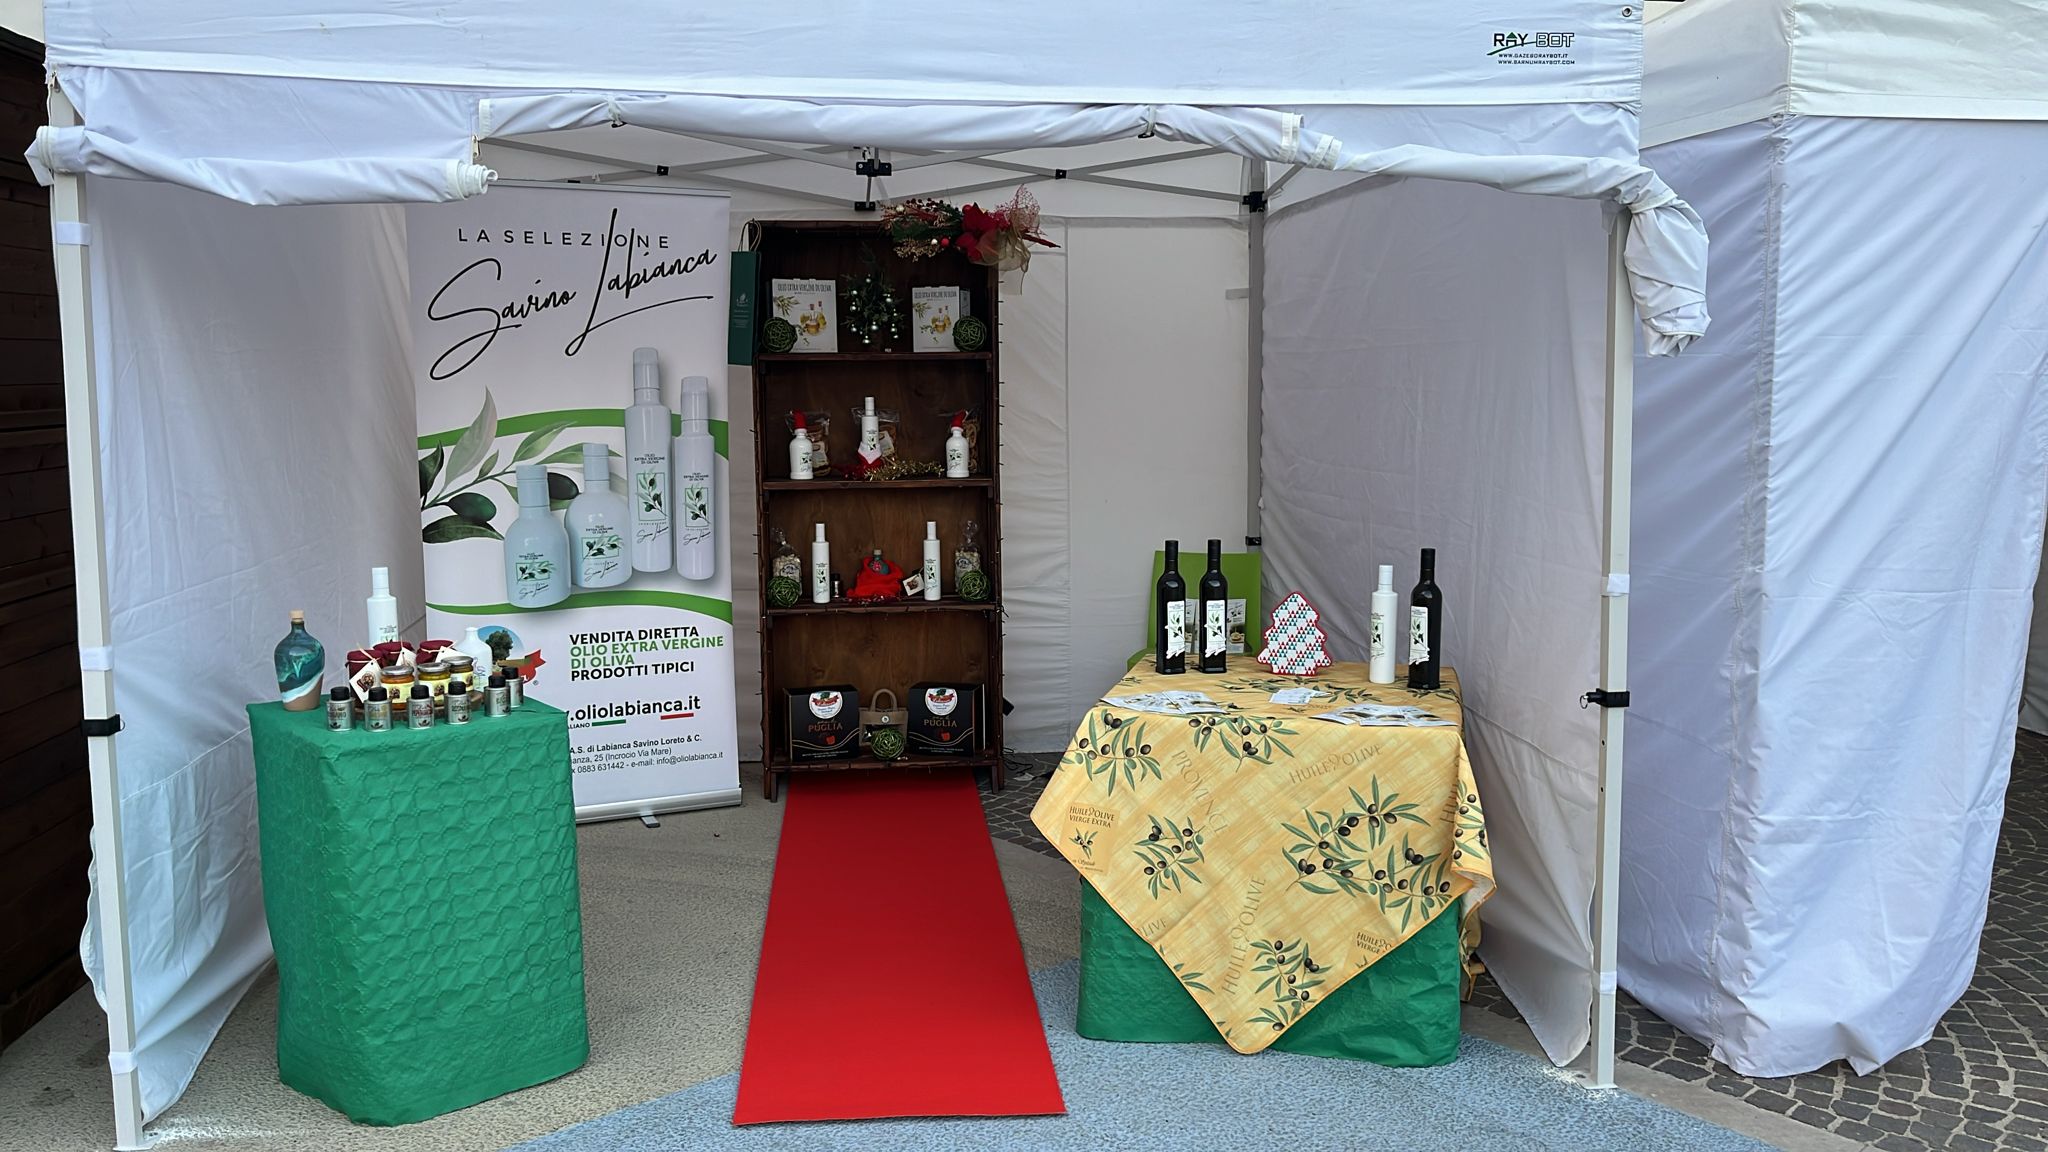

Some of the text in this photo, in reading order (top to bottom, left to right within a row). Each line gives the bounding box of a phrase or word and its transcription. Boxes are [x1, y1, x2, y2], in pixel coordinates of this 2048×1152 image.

[1493, 31, 1575, 48] RAY BOT
[458, 228, 669, 249] LA SELEZIONE
[428, 258, 576, 380] Savino
[569, 626, 699, 645] VENDITA DIRETTA
[570, 635, 724, 657] OLIO EXTRA VERGINE
[571, 654, 635, 669] DI OLIVA
[571, 661, 694, 681] PRODOTTI TIPICI
[567, 695, 701, 721] .oliolabianca.it
[808, 722, 843, 733] PUGLIA
[923, 719, 958, 728] PUGLIA
[570, 734, 702, 754] A.S. di Labianca Savino Loreto & C.
[573, 747, 672, 764] anza, 25 (Incrocio Via Mare)
[577, 764, 595, 773] 0883
[597, 761, 625, 772] 631442
[630, 759, 655, 768] e-mail:
[656, 751, 724, 766] info@oliolabianca.it
[1069, 814, 1111, 828] VIERGE EXTRA
